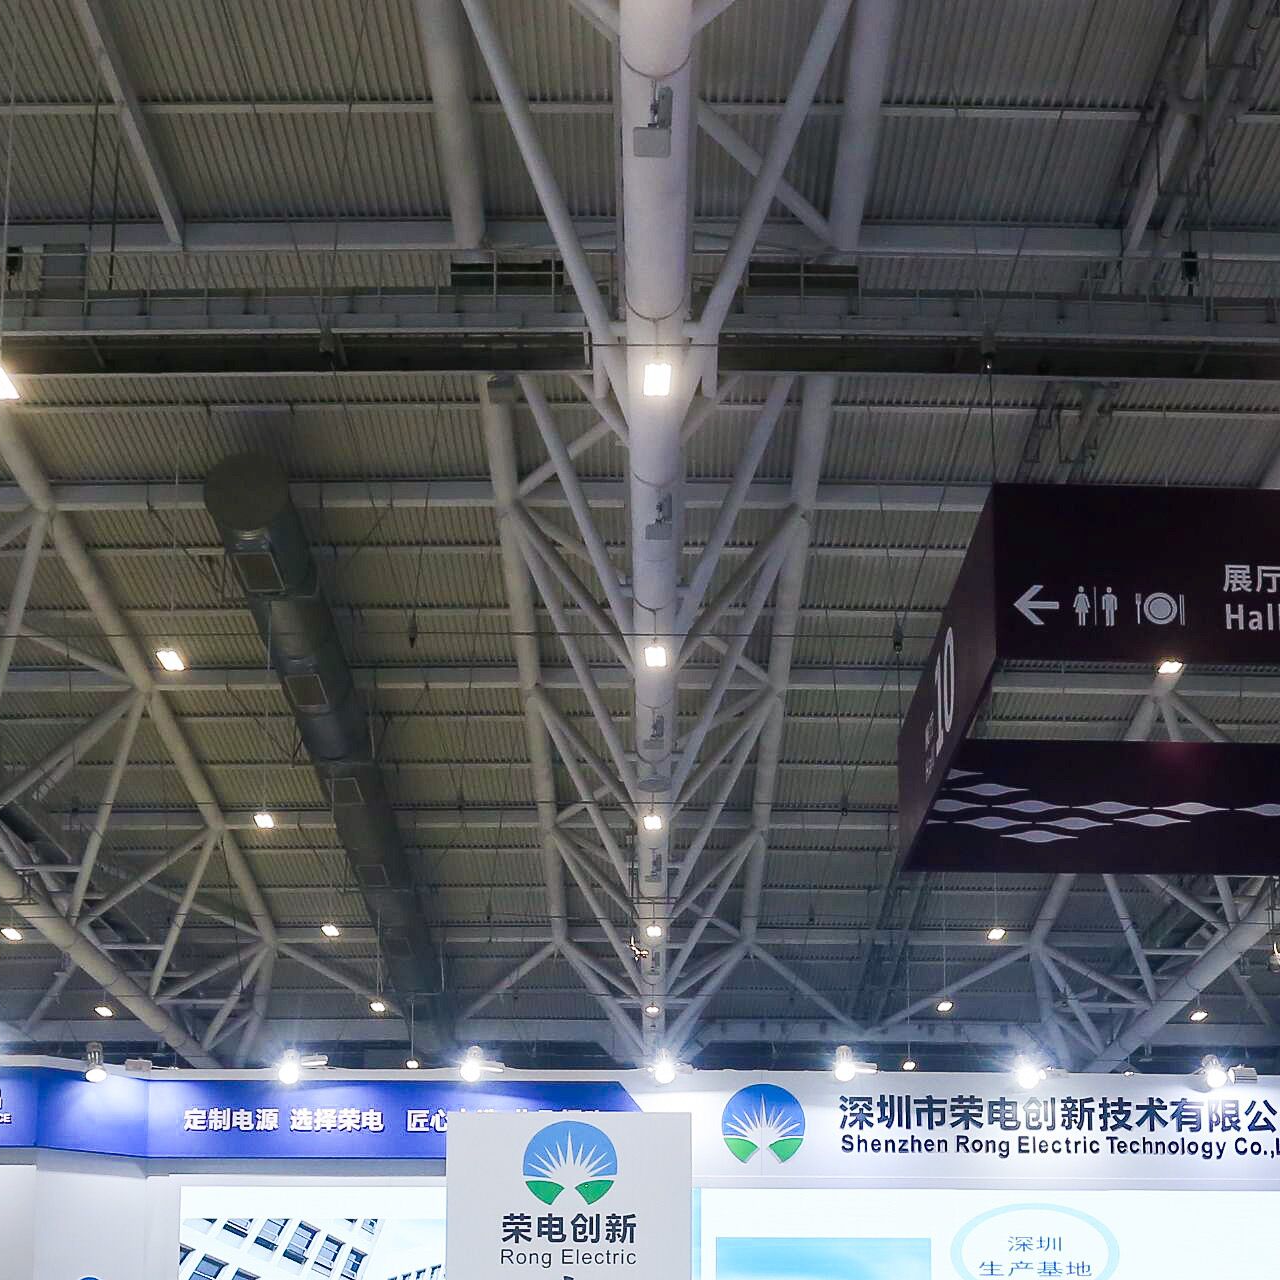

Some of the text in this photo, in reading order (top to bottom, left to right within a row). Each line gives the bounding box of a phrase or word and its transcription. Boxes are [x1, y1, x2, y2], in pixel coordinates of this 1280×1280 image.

[935, 626, 954, 757] 10
[184, 1108, 279, 1131] 定制电源
[290, 1108, 384, 1132] 选择荣电
[841, 1135, 948, 1154] Shenzhen
[956, 1135, 1010, 1158] Rong
[1018, 1136, 1100, 1154] Electric
[1106, 1137, 1226, 1160] Technology
[502, 1213, 637, 1243] 荣电创新
[1007, 1236, 1062, 1252] 深圳
[501, 1249, 636, 1268] Rong Electric
[979, 1261, 1092, 1277] 生产基地
